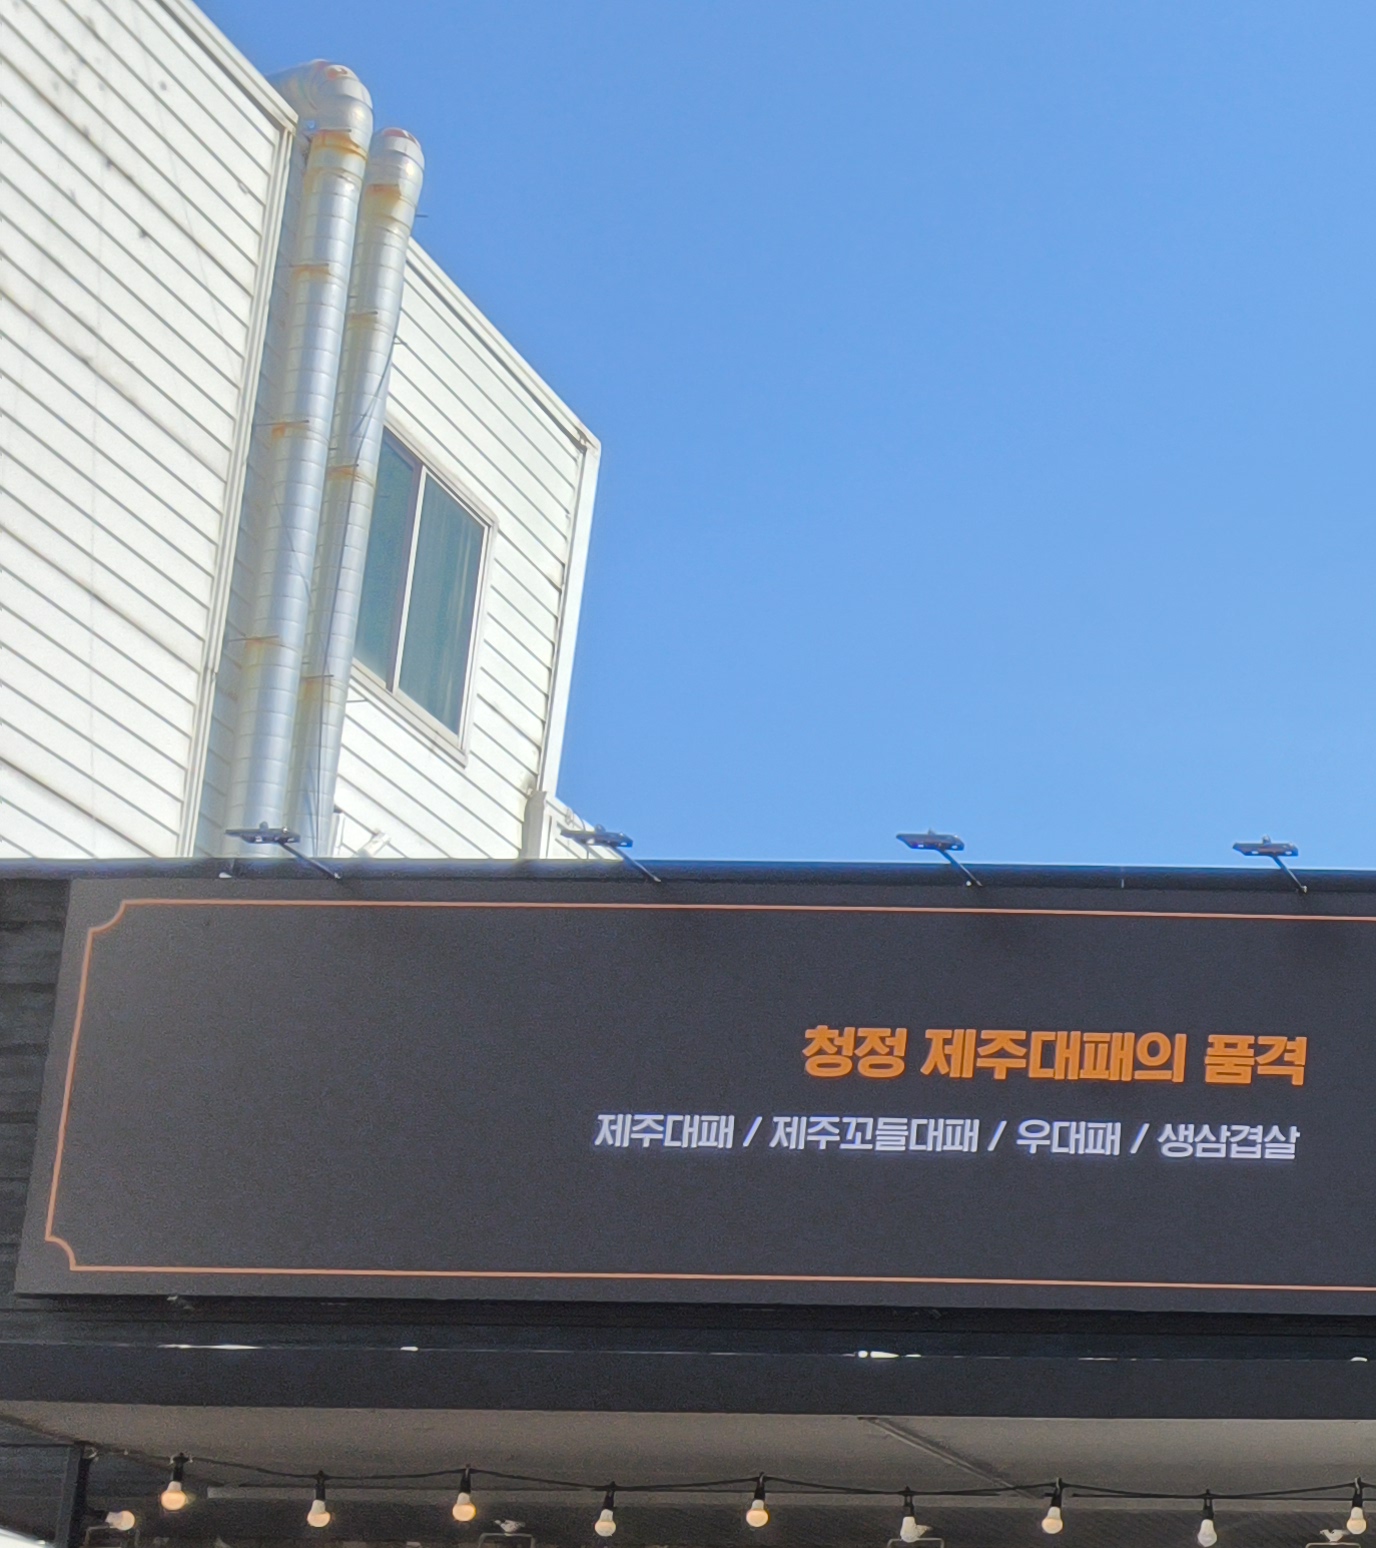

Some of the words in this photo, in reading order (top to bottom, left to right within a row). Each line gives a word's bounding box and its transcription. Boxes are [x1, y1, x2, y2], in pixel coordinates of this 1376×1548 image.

[803, 1025, 909, 1080] 청정
[921, 1029, 1188, 1085] 제주대패의
[1204, 1034, 1309, 1087] 품격
[594, 1113, 734, 1150] 제주대패
[769, 1116, 981, 1153] 제주꼬들대패
[1015, 1120, 1122, 1156] 우대패
[1157, 1121, 1301, 1160] 생삼겹살
